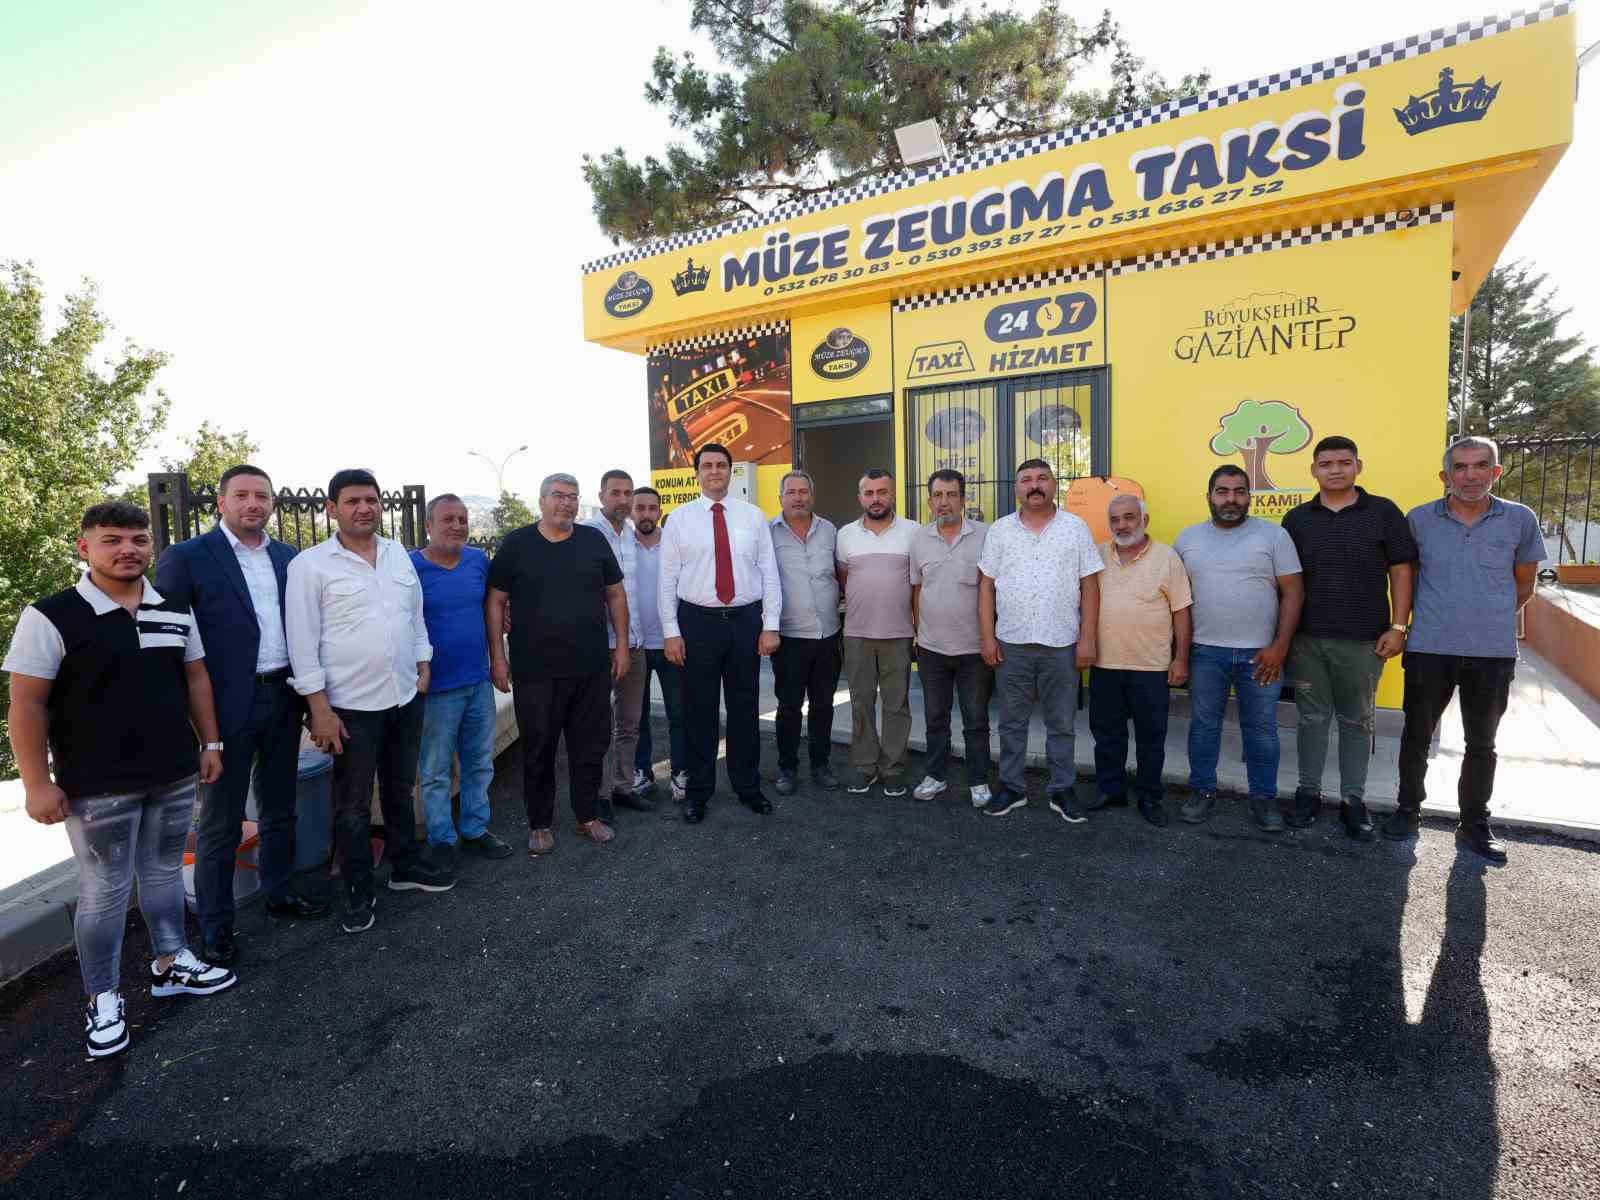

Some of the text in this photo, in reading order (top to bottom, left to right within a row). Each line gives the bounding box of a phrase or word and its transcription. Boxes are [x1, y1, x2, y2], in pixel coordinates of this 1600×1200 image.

[722, 89, 1366, 293] MÜZE ZEUGMA TAKSİ
[763, 286, 774, 296] 0
[777, 280, 805, 294] 532
[809, 272, 838, 286] 678
[842, 266, 864, 280] 30
[868, 261, 889, 274] 83
[908, 255, 921, 265] 0
[926, 246, 962, 262] 530
[967, 237, 1002, 254] 393
[1007, 231, 1034, 245] 87
[1039, 224, 1066, 238] 27
[1088, 217, 1104, 228] 0
[1109, 206, 1150, 225] 531
[1158, 196, 1204, 215] 636
[1211, 188, 1244, 204] 27
[1249, 179, 1284, 197] 52
[998, 301, 1086, 335] 24 7
[989, 341, 1093, 372] HİZMET
[1174, 315, 1357, 364] GAZİANTEP
[681, 377, 724, 407] TAXI
[655, 477, 683, 489] KONUM
